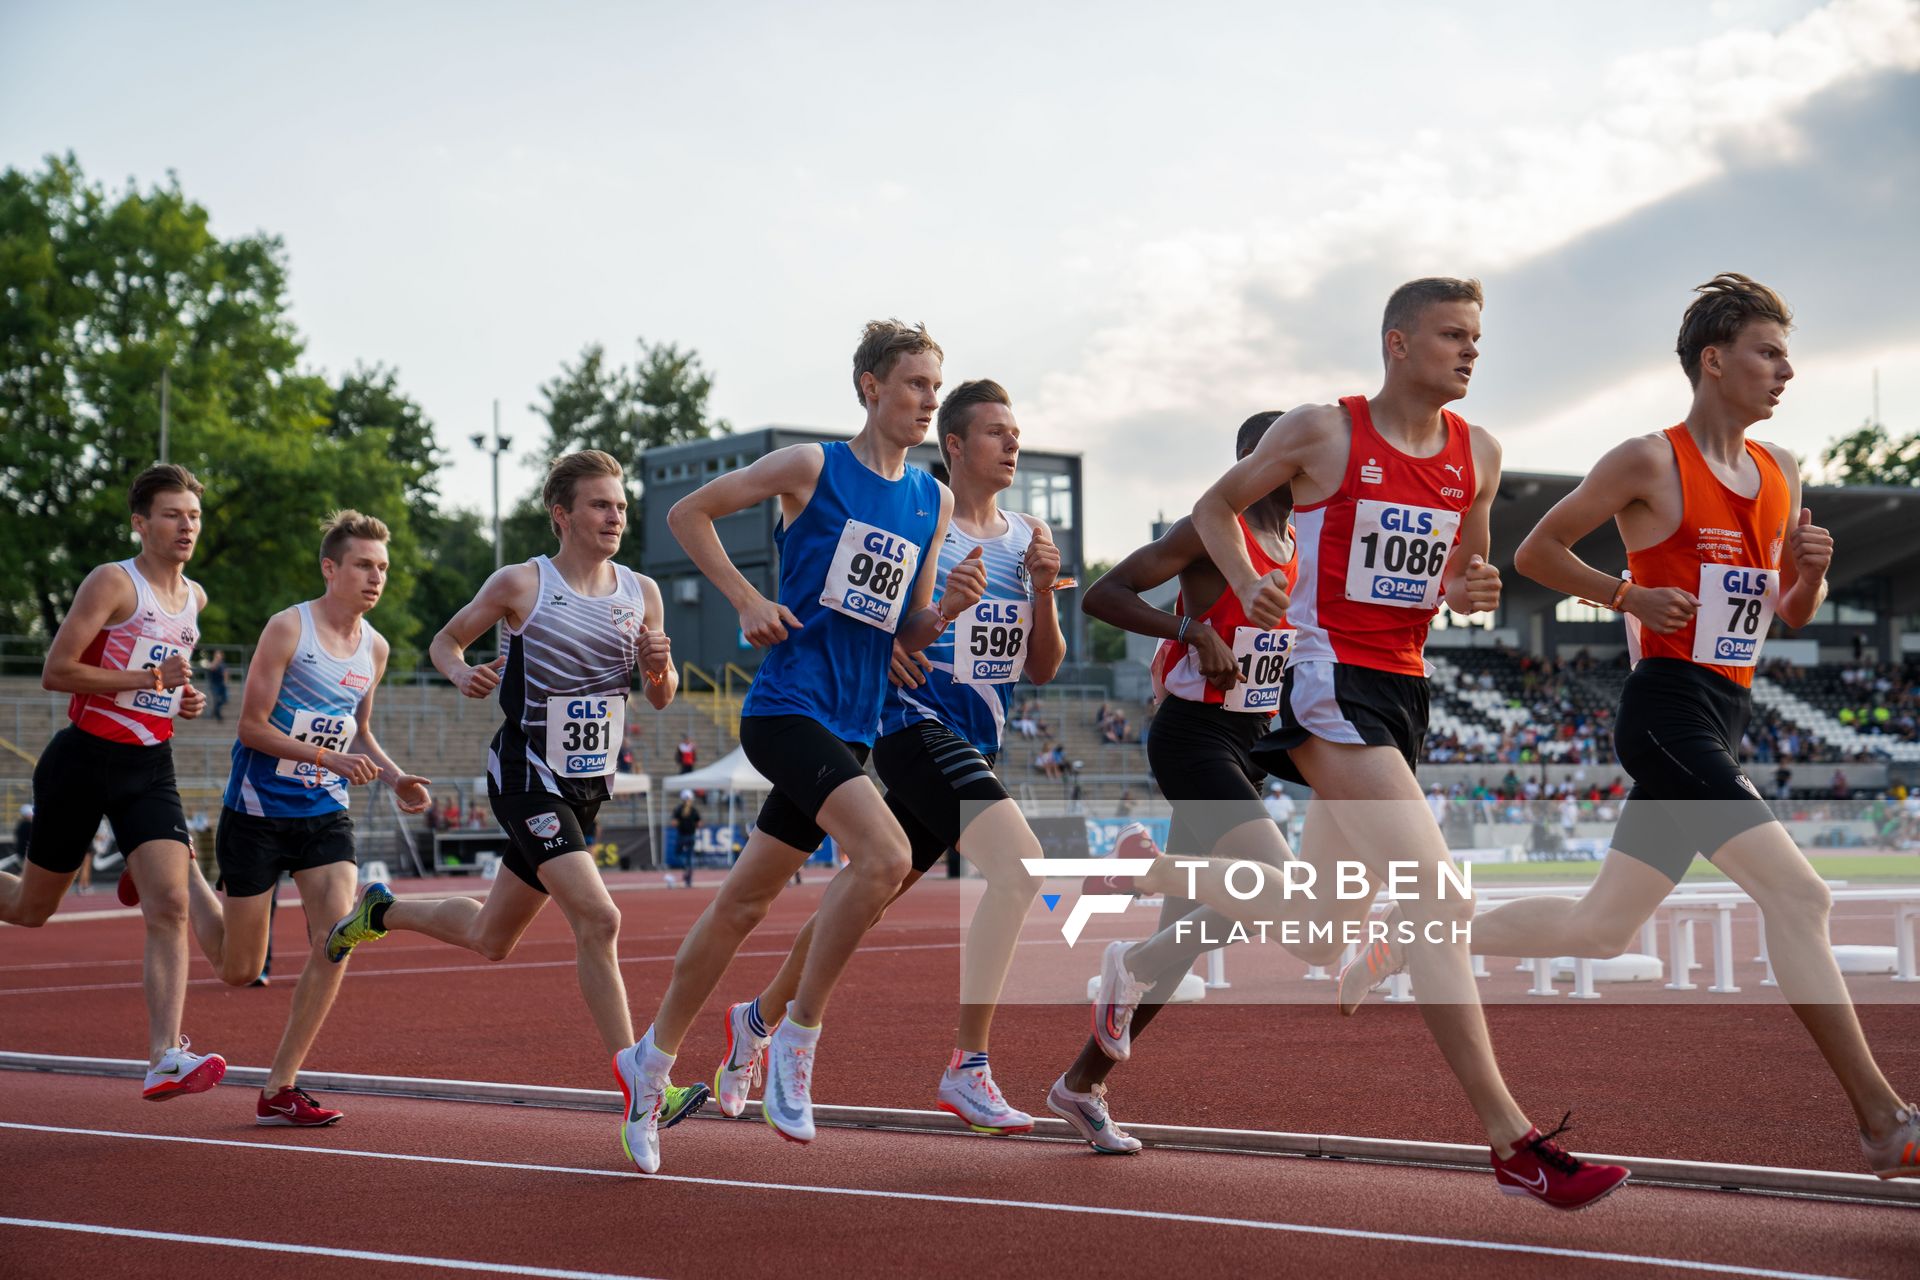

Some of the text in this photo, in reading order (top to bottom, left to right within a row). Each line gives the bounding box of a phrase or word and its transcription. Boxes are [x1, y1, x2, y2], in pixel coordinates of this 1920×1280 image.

[1360, 532, 1447, 577] 1086
[847, 553, 904, 601] 988
[1396, 582, 1425, 594] PLAN
[866, 600, 889, 616] PLAN
[1727, 597, 1761, 635] 78
[970, 626, 1023, 657] 598
[1735, 642, 1755, 654] PLAN
[991, 662, 1012, 673] PLAN
[151, 696, 171, 708] PLAN
[1261, 691, 1278, 700] PLAN
[562, 721, 609, 751] 381
[587, 757, 606, 767] PLAN
[528, 816, 541, 826] KSV
[543, 837, 568, 851] N.F.
